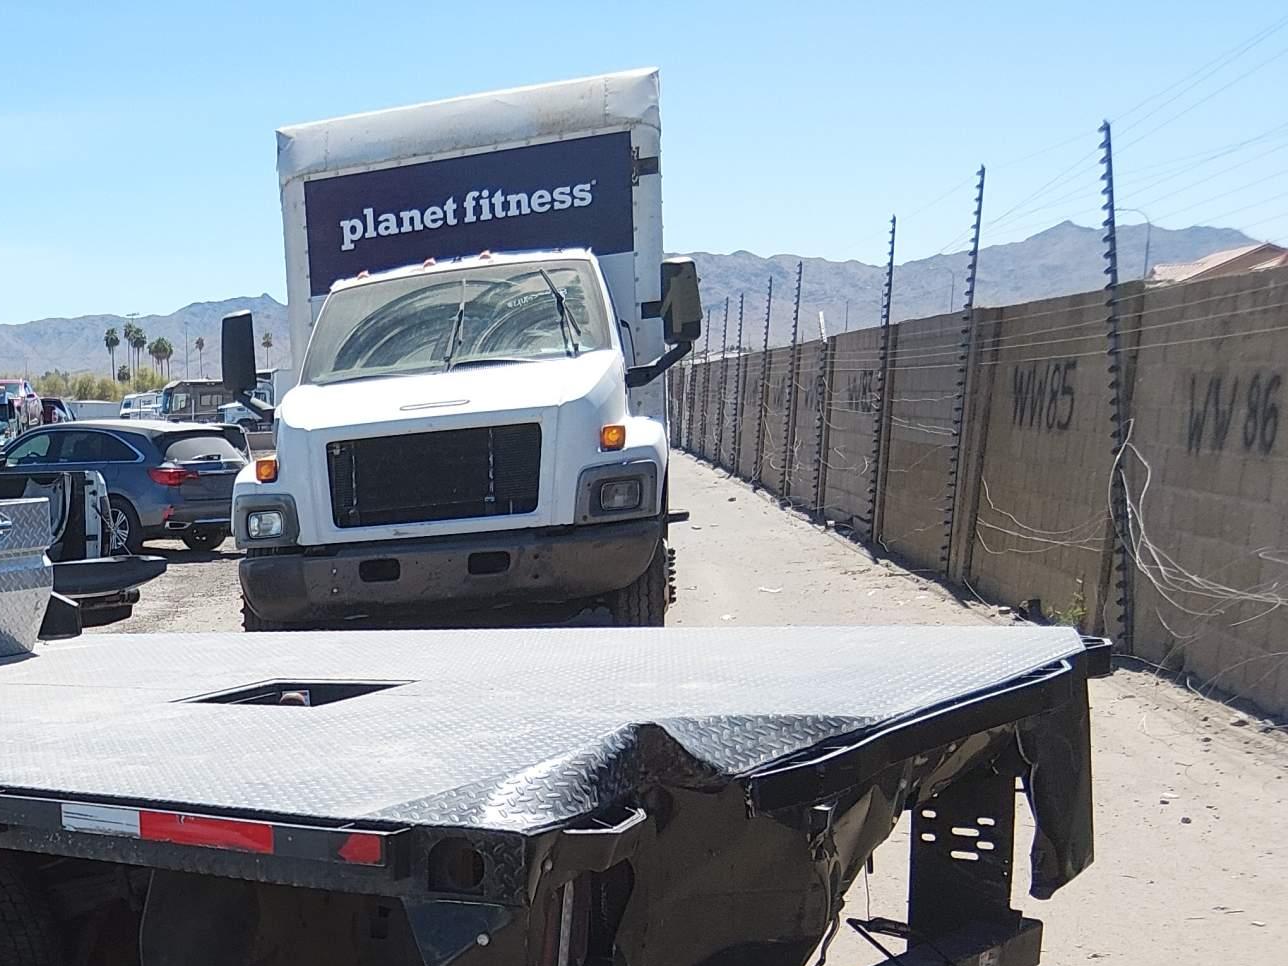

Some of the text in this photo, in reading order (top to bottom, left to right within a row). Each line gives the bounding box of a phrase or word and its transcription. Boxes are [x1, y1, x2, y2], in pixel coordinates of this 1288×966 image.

[340, 181, 594, 251] planet fitness
[1013, 359, 1078, 432] WW85
